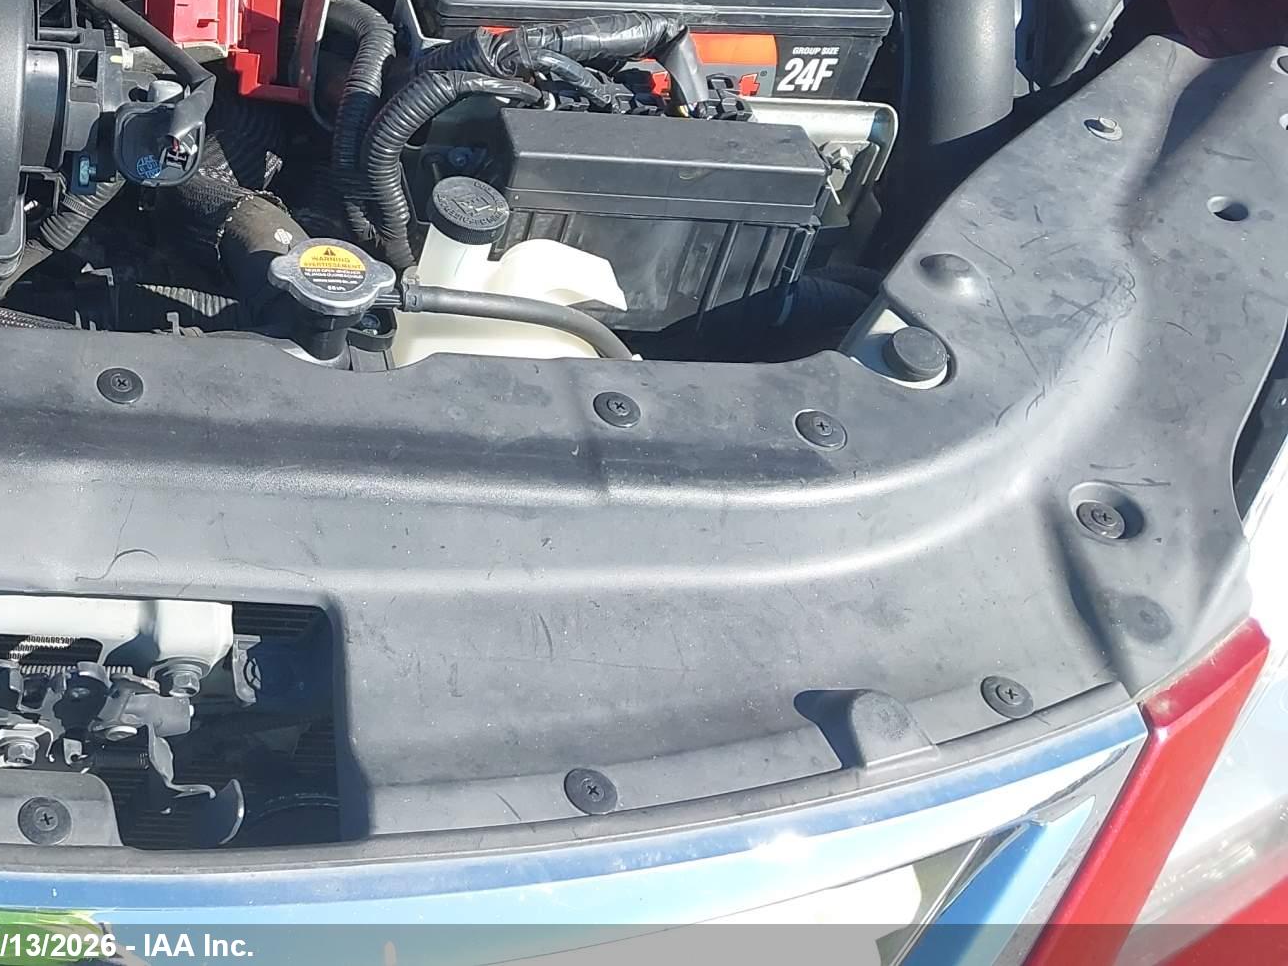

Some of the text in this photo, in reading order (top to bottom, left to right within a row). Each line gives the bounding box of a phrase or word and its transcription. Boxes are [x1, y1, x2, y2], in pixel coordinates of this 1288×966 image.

[792, 46, 840, 55] GROUP SIZE
[777, 58, 839, 92] 24F
